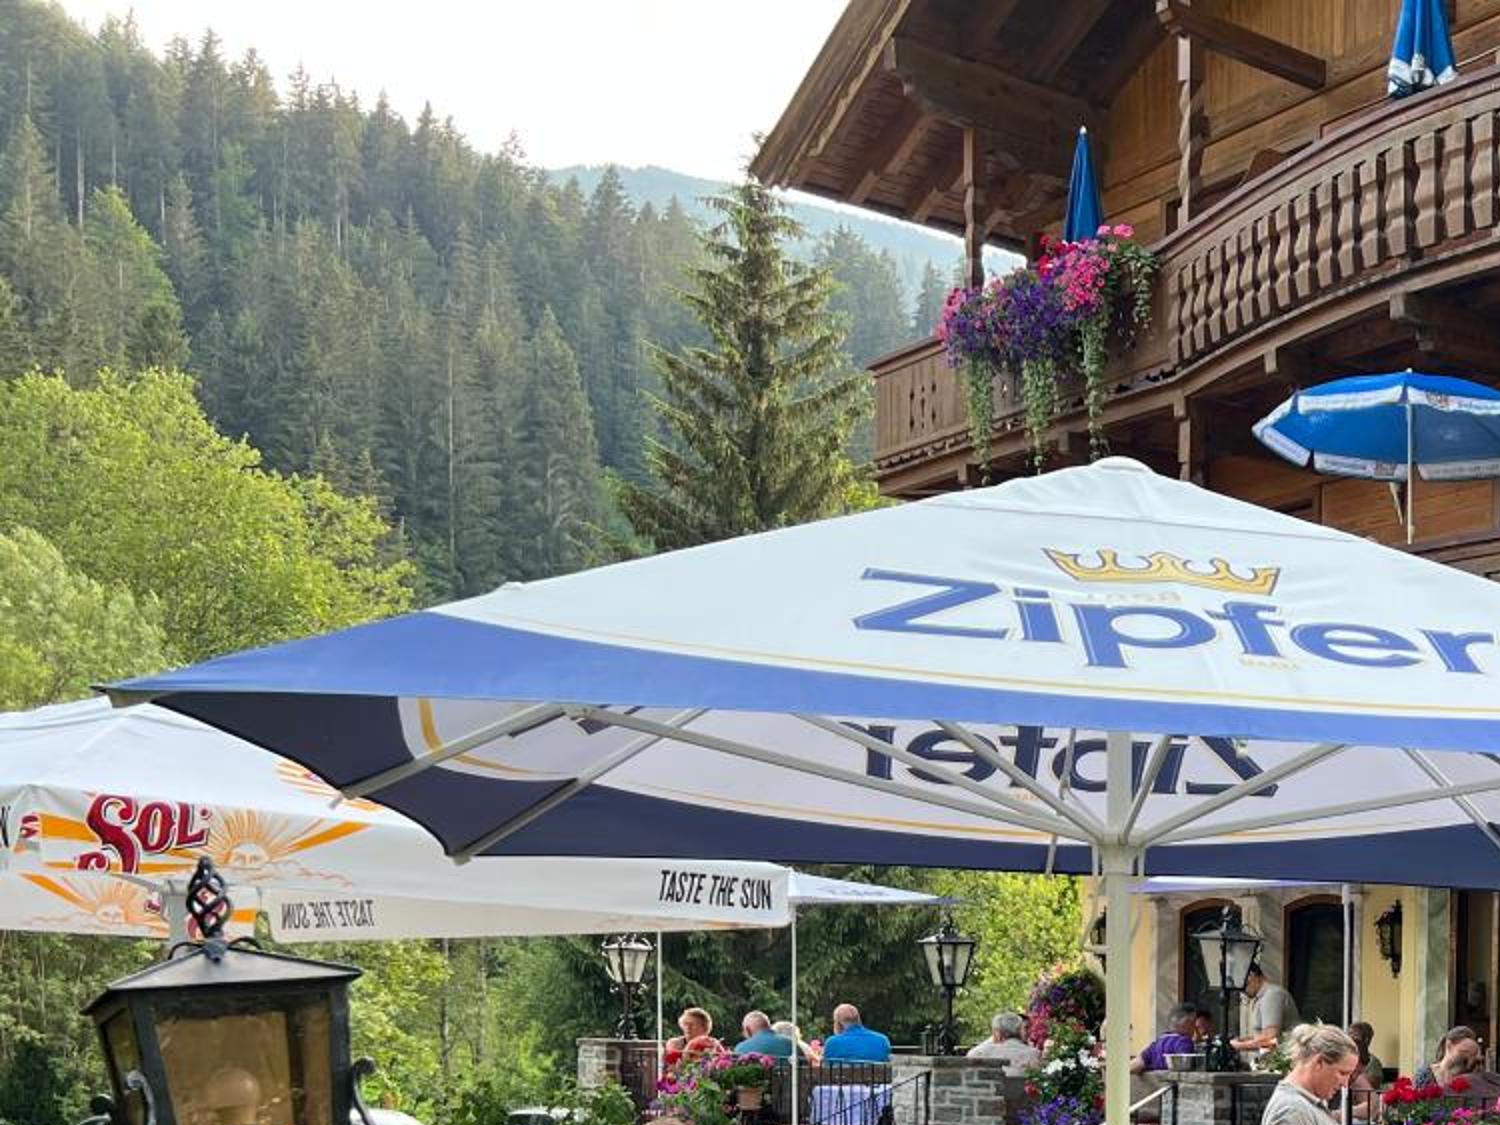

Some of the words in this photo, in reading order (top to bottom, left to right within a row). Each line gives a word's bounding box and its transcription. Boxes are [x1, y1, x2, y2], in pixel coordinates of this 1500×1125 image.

[852, 567, 1495, 674] Zipfer
[659, 870, 707, 904] TASTE
[709, 875, 738, 908] THE
[740, 879, 772, 910] SUN
